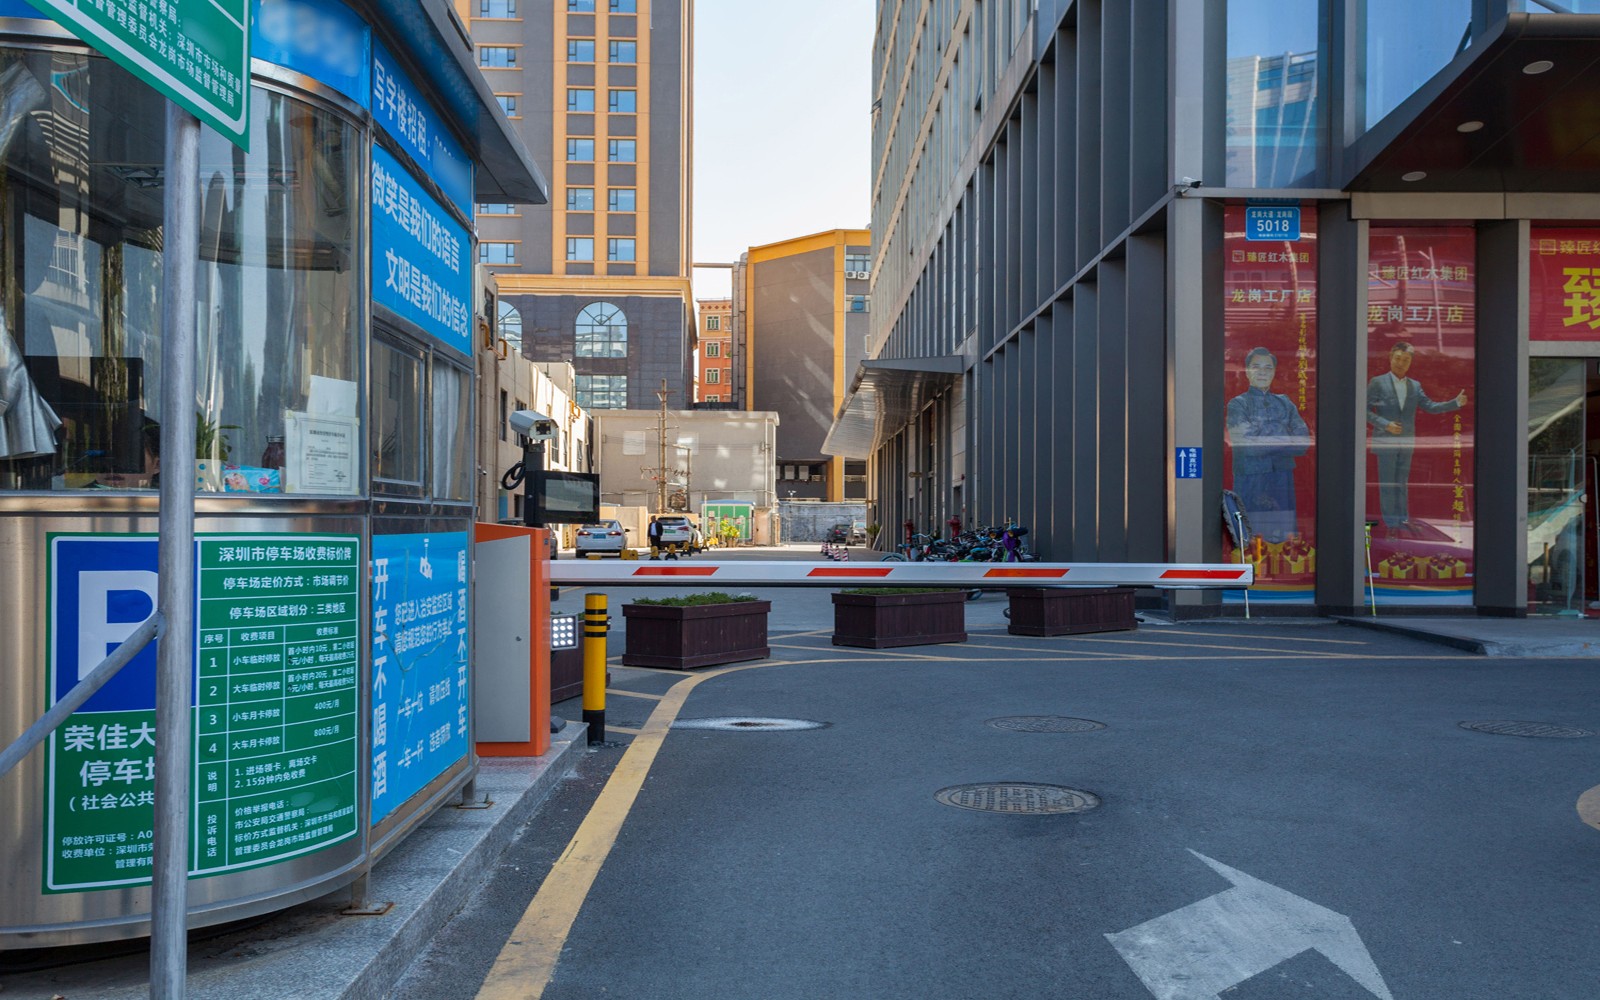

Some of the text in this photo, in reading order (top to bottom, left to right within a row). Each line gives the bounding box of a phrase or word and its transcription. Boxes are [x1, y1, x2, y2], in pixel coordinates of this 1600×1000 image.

[372, 160, 460, 275] 微笑是我们的语言
[1257, 220, 1289, 232] 5018
[385, 248, 468, 338] 文明是我们的信念
[1231, 288, 1312, 303] 龙岗工厂店
[1367, 305, 1464, 323] 龙岗工厂店
[218, 546, 352, 562] 深圳市停车场收费标价牌
[223, 574, 349, 590] 停车场定价方式：市场调节价
[229, 602, 346, 620] 停车场区域划分：三类地区
[78, 570, 158, 681] P
[204, 626, 339, 644] 序号 收费项目 收费标准
[457, 550, 467, 739] 喝酒不开车
[209, 658, 217, 668] 1
[233, 653, 280, 665] 小车临时停放
[373, 558, 388, 799] 开车不喝酒
[209, 686, 217, 697] 2
[232, 681, 280, 694] 大车临时停放
[209, 699, 340, 725] 3 小车月卡停放 400元/月
[208, 725, 340, 753] 4 大车月卡停放 800元/月
[207, 814, 217, 857] 投诉电话
